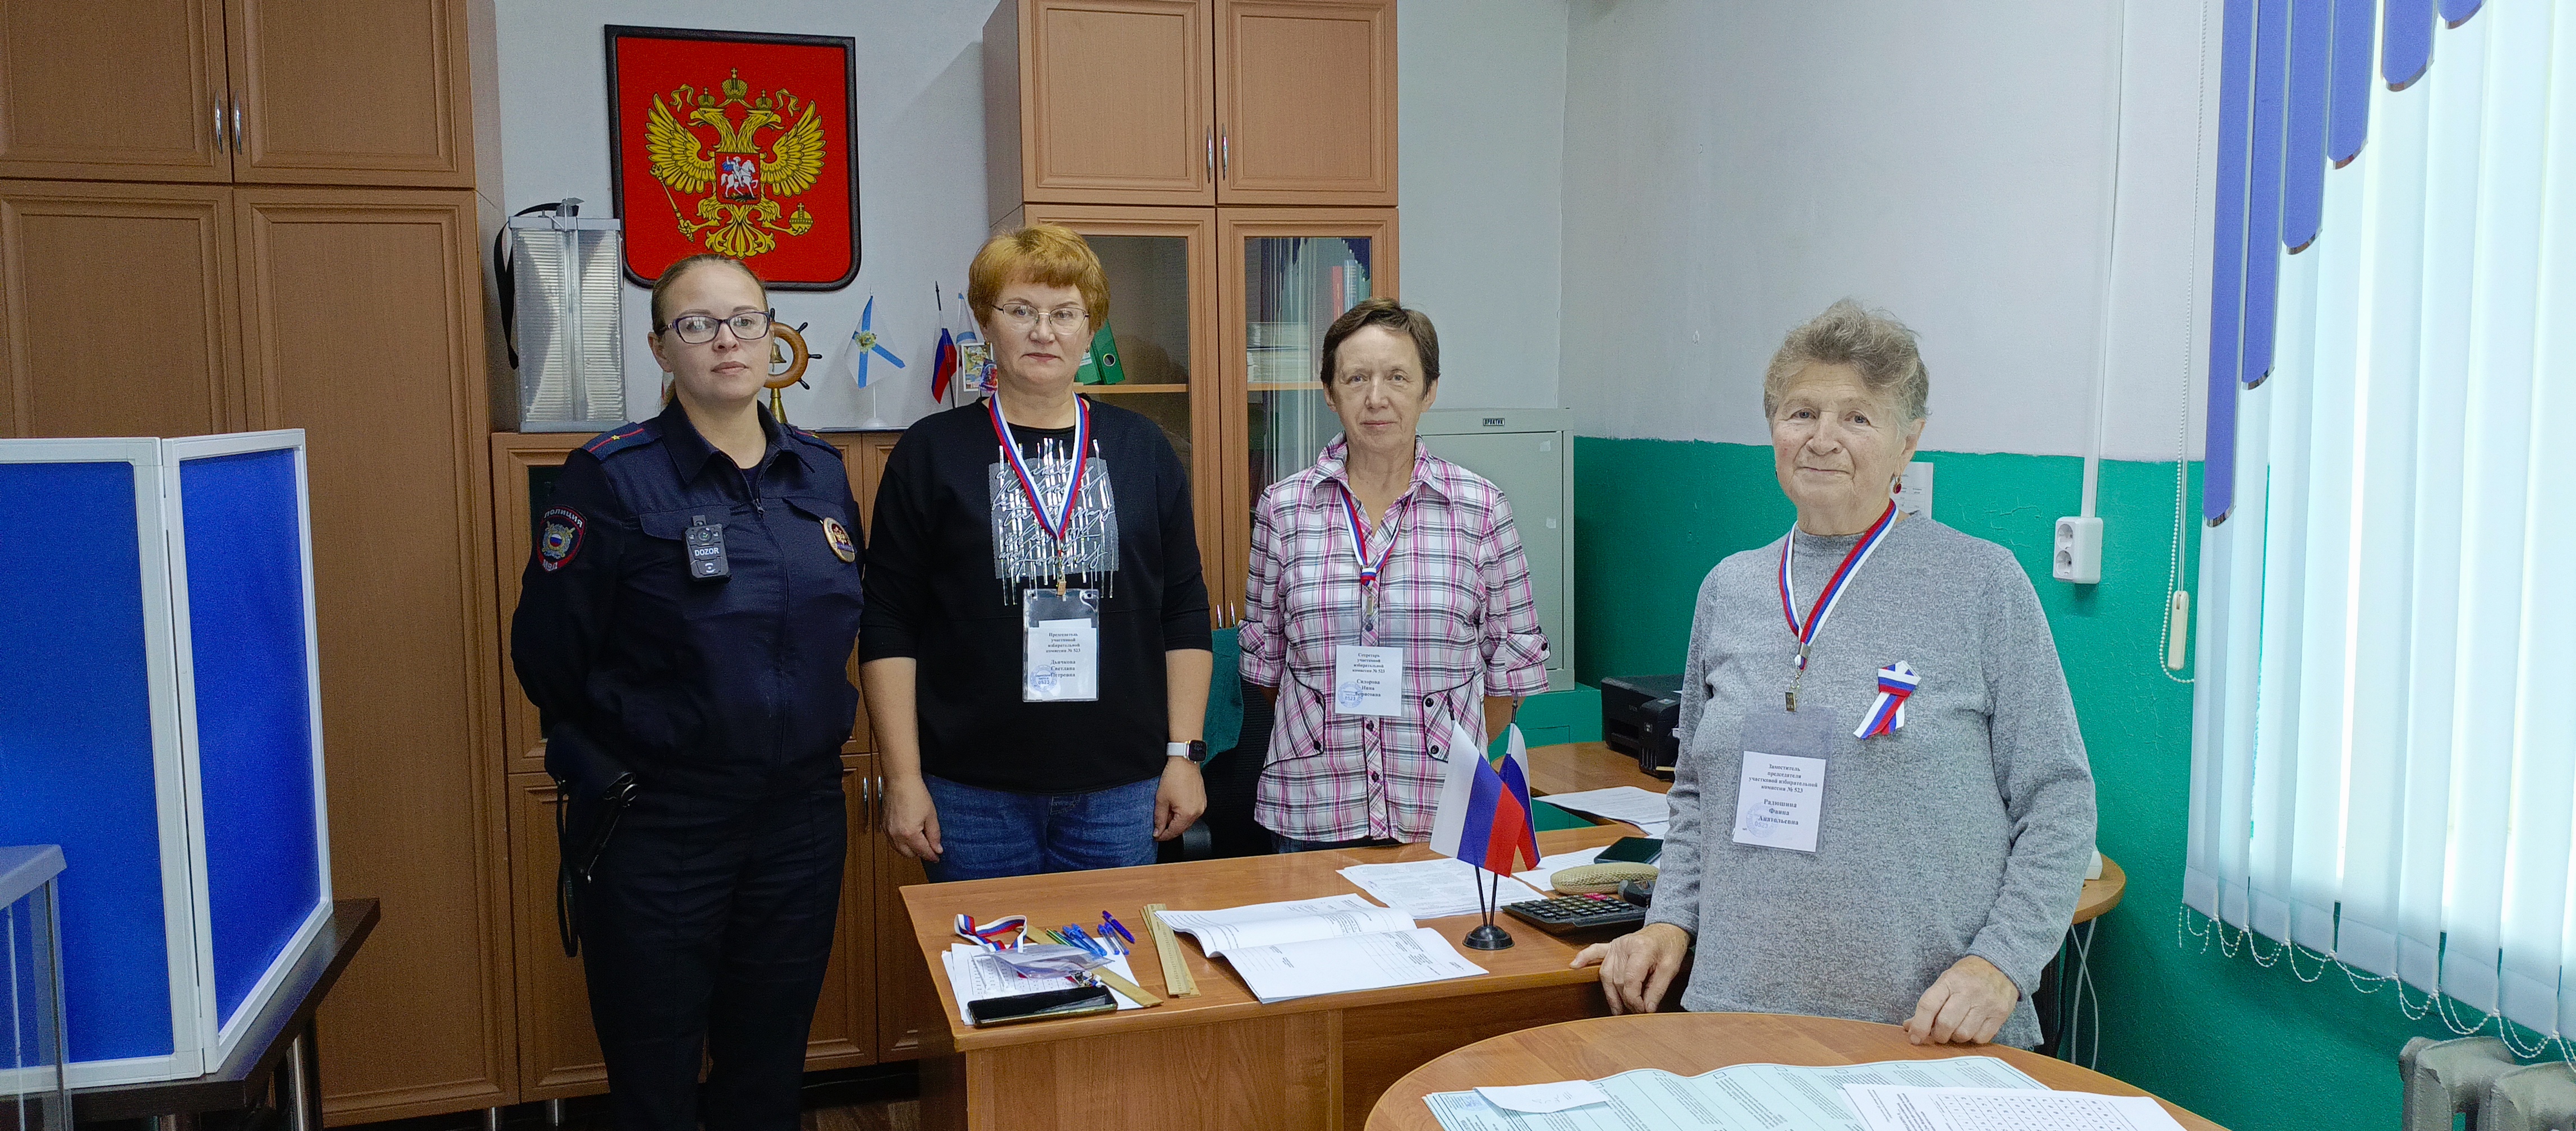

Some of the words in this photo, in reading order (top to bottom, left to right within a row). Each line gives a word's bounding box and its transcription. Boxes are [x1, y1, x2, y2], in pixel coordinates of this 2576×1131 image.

[544, 509, 583, 528] ПОЛИЦИЯ
[694, 548, 720, 556] DOZOR
[542, 559, 558, 571] МВД
[1758, 816, 1798, 825] Анатольевна
